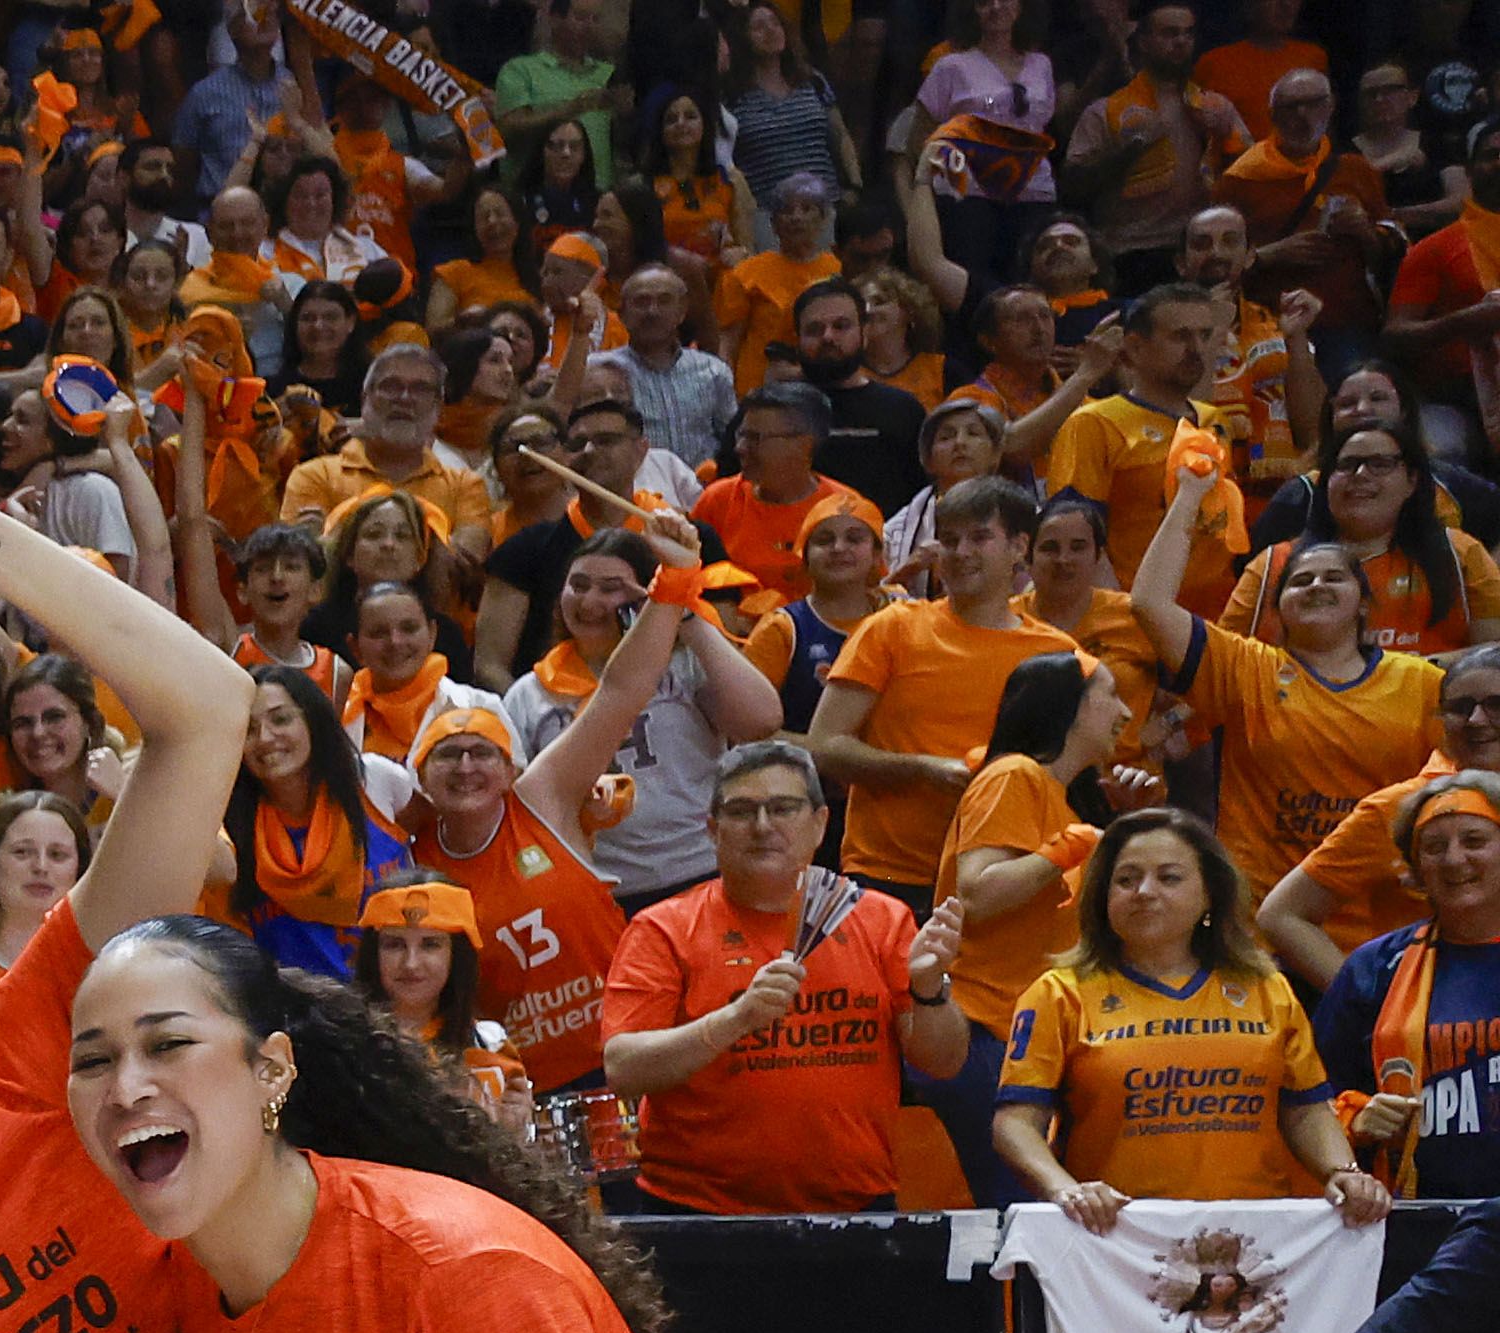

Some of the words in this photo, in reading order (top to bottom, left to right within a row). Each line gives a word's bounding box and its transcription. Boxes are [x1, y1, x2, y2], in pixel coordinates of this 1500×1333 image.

[384, 39, 467, 110] BASKET
[495, 908, 561, 970] 13
[850, 992, 879, 1010] del
[1124, 1066, 1242, 1092] Cultura
[1124, 1092, 1265, 1120] Esfuerzo
[24, 1226, 77, 1282] del
